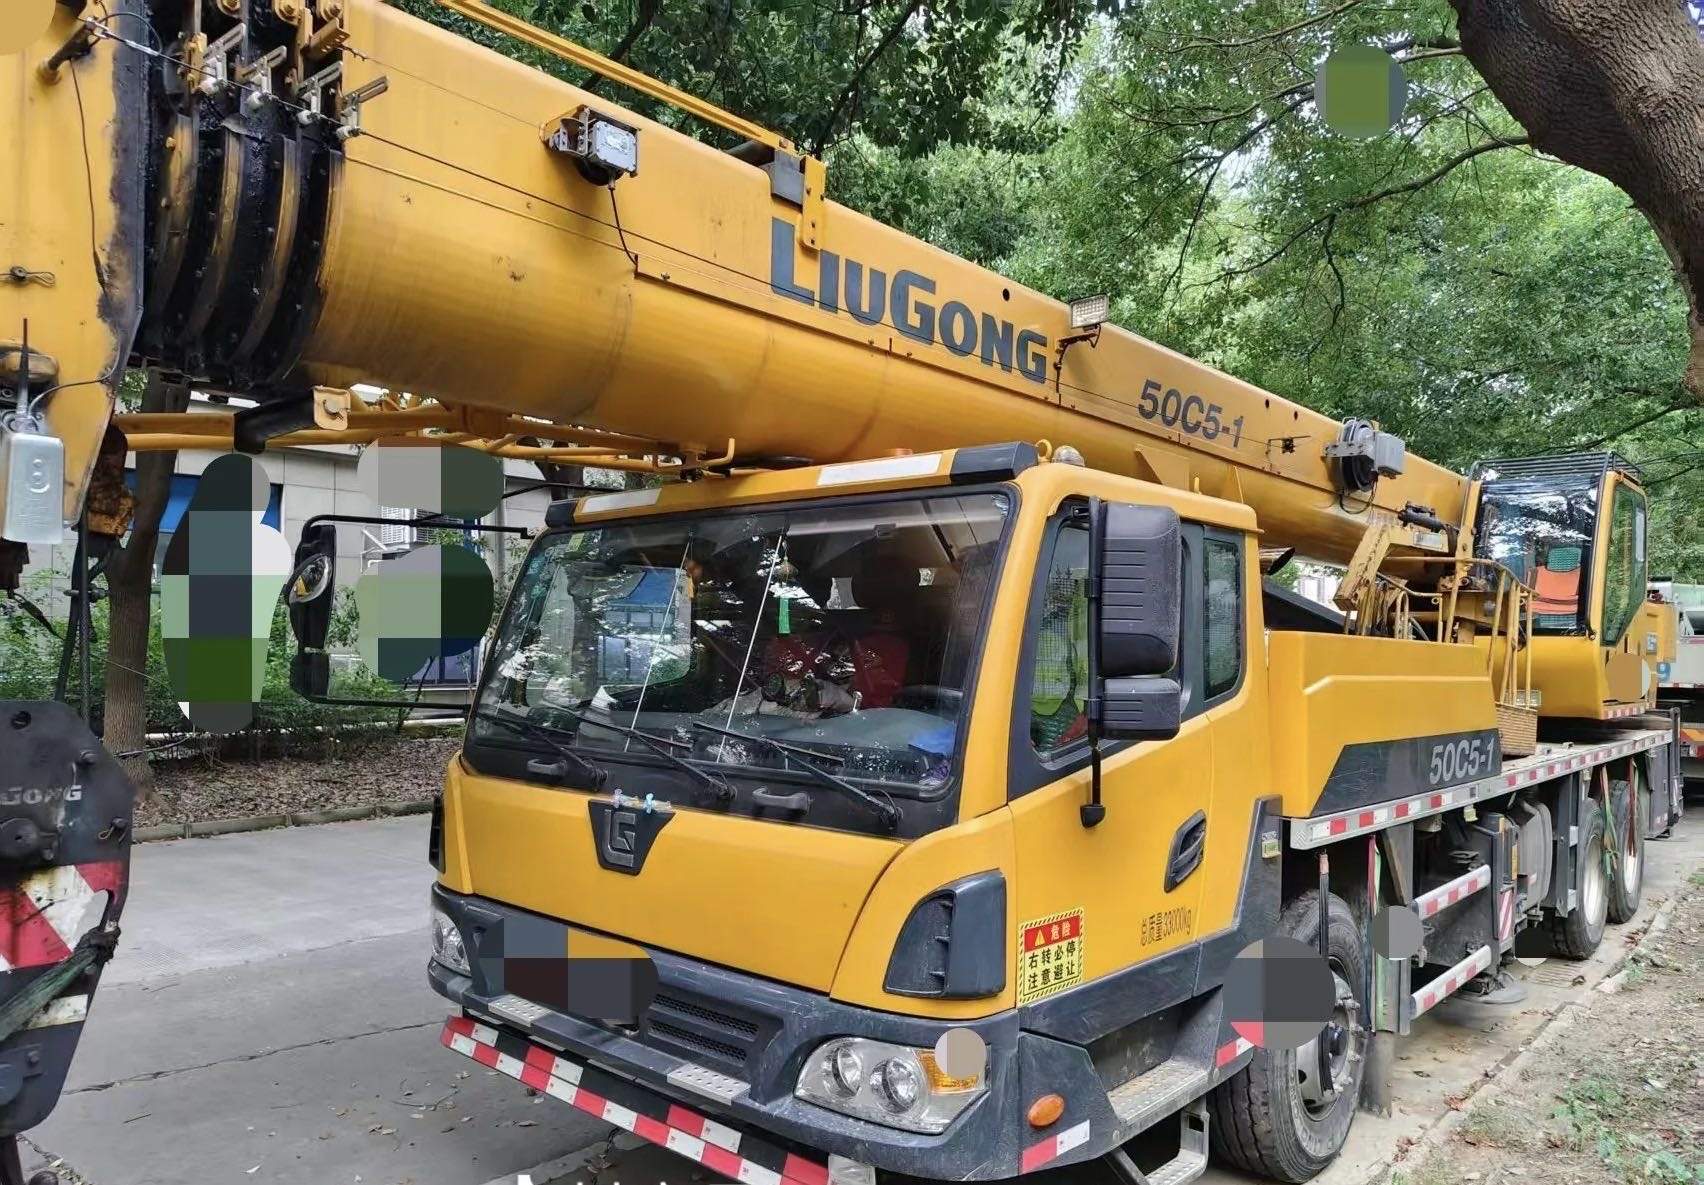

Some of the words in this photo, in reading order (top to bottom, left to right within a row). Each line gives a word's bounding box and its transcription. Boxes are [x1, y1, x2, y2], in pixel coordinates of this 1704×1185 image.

[1138, 379, 1244, 448] 50C5-1
[1429, 737, 1495, 785] 50C5-1
[1050, 921, 1072, 940] 危险
[1028, 939, 1076, 970] 右转必停
[1027, 961, 1075, 990] 注意避让
